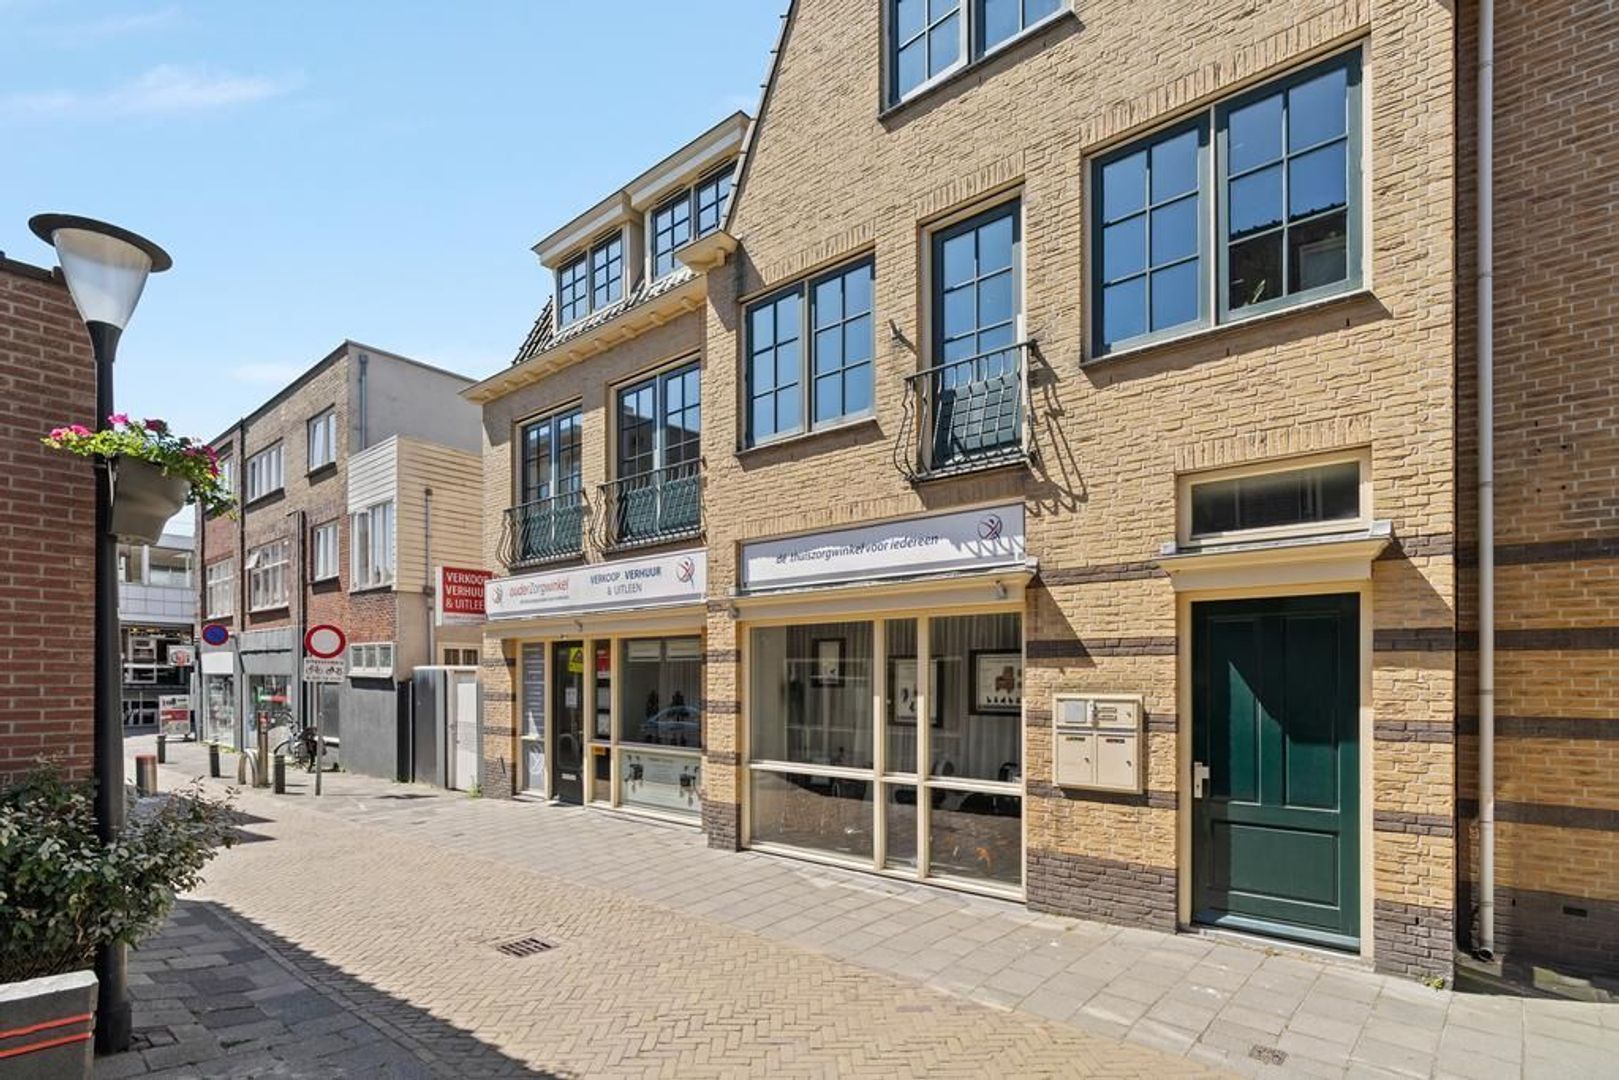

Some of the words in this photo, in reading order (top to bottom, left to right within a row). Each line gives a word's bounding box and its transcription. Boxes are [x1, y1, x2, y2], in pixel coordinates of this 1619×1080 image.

[866, 541, 889, 553] voor
[890, 535, 939, 550] iedereen
[590, 571, 621, 585] VERKOOP
[625, 566, 661, 580] VERHUUR
[445, 584, 484, 598] VERHUU
[614, 583, 643, 596] UITLEEN
[446, 598, 453, 609] &
[455, 599, 484, 610] UITLEE
